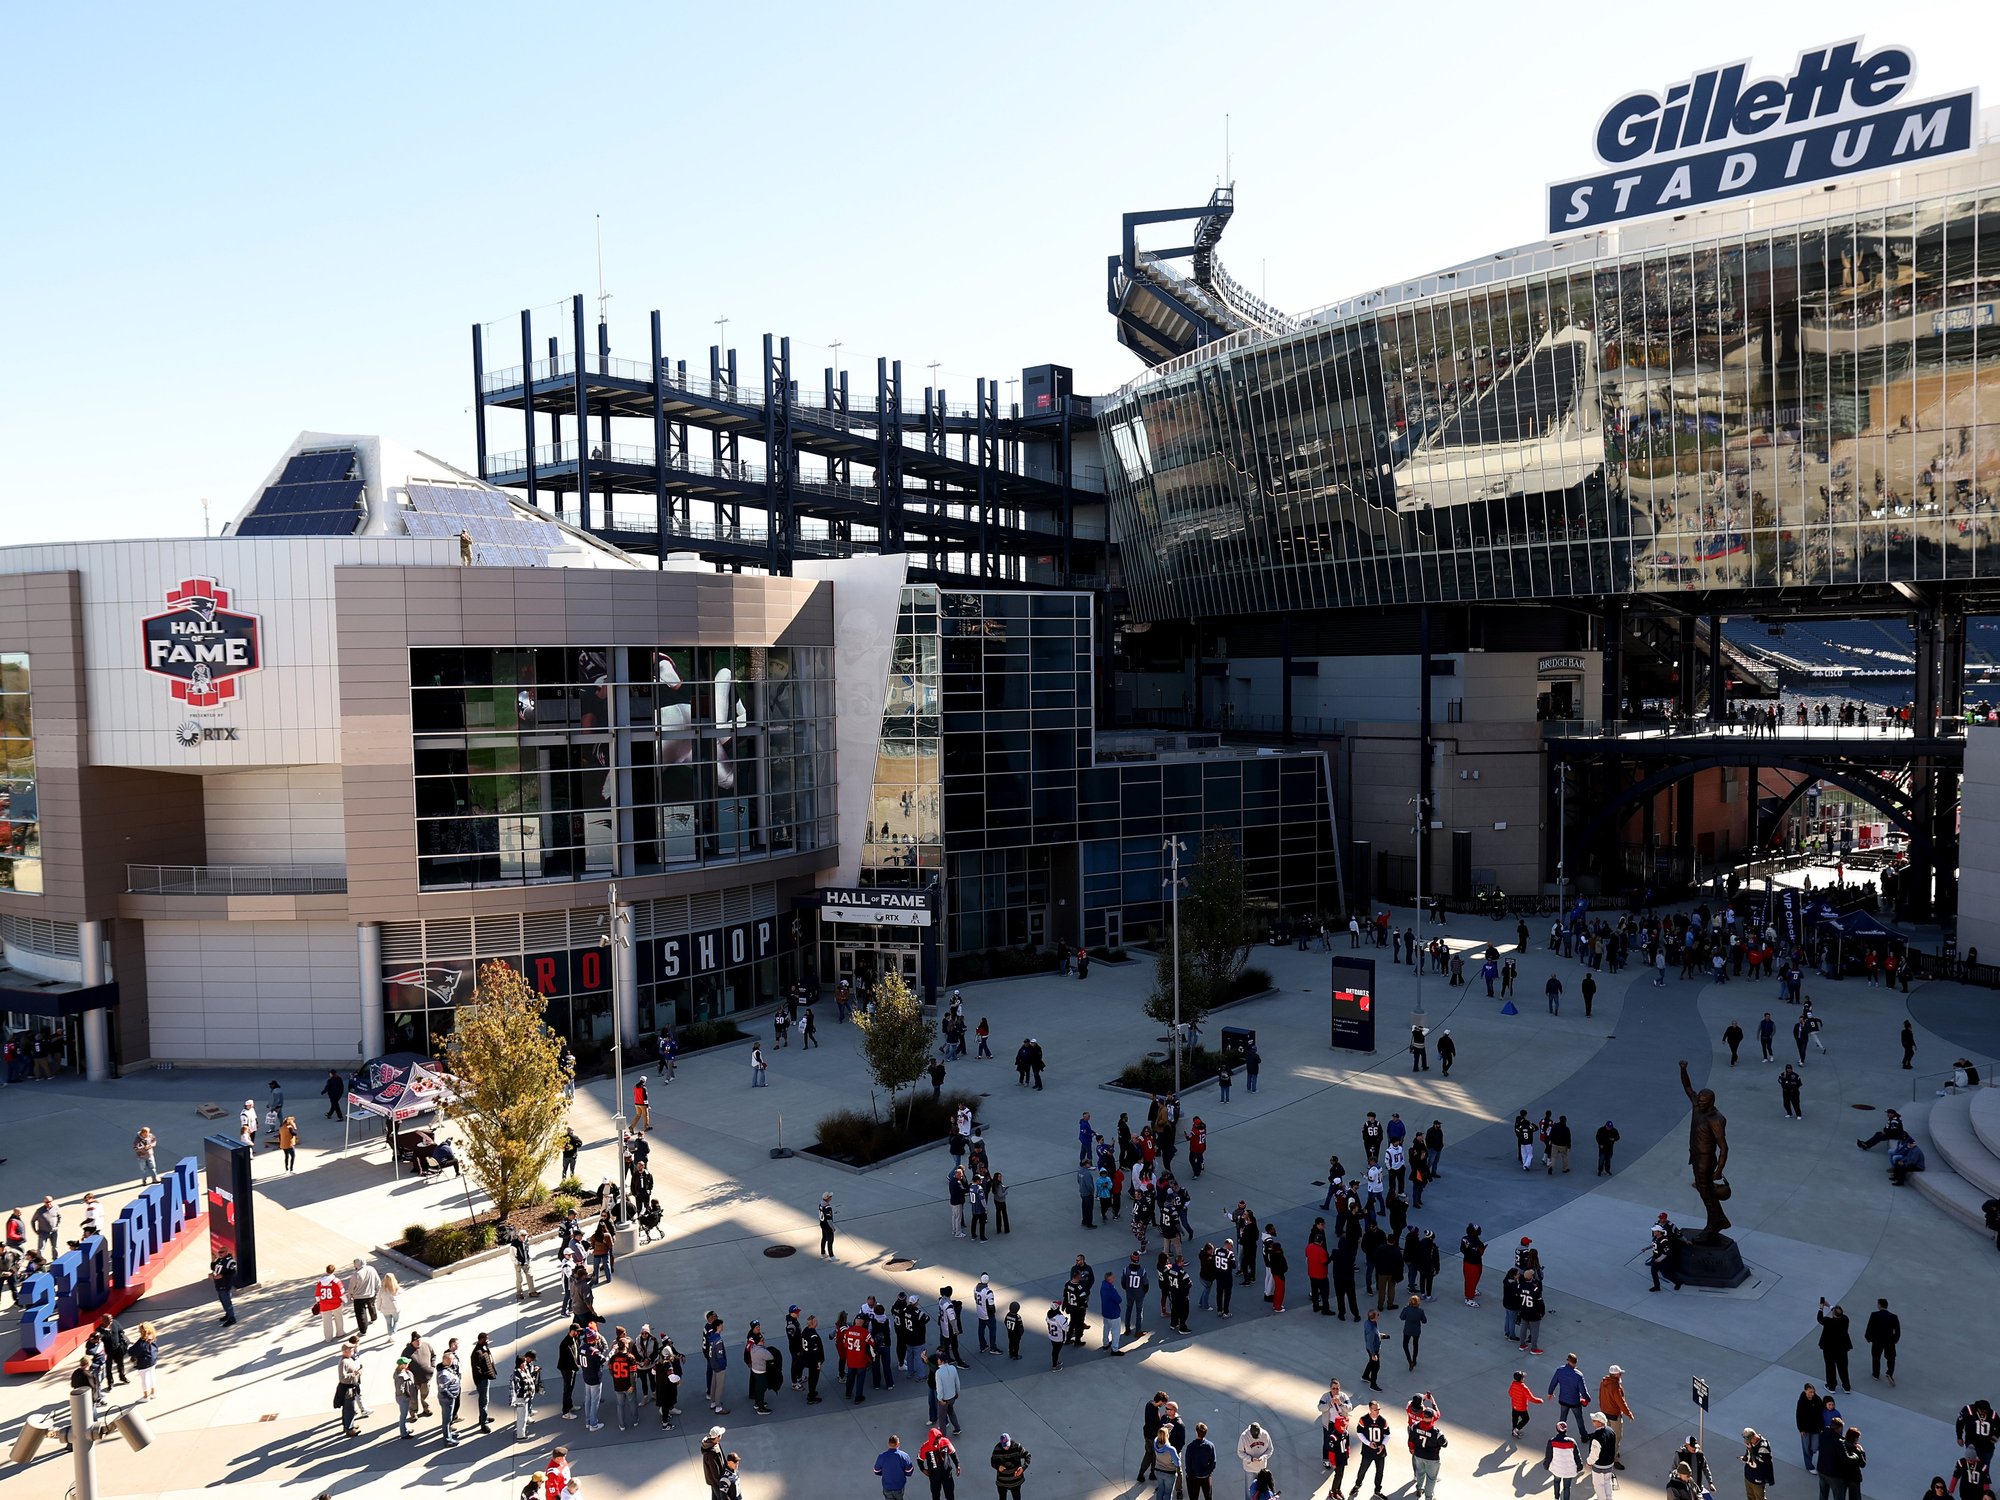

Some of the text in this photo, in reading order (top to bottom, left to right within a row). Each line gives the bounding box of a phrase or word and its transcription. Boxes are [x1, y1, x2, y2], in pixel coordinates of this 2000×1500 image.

[1597, 41, 1911, 163] Gillette
[1564, 106, 1953, 224] STADIUM
[171, 621, 225, 635] HALL
[191, 635, 204, 643] OF
[149, 638, 249, 667] FAME
[1540, 657, 1585, 670] BRIDGE BAR
[203, 728, 237, 741] RTX
[826, 891, 871, 905] HALL
[881, 894, 926, 907] FAME
[1783, 892, 1792, 909] VIP
[664, 921, 771, 977] SHOP
[1367, 1126, 1378, 1136] 66
[1215, 1255, 1229, 1271] 85
[1129, 1275, 1141, 1289] 10
[320, 1287, 334, 1300] 38
[1066, 1291, 1078, 1307] 12
[1520, 1293, 1534, 1308] 76
[904, 1318, 914, 1332] 12
[1006, 1319, 1016, 1331] 87
[847, 1337, 861, 1352] 54
[613, 1361, 630, 1379] 95
[1369, 1427, 1381, 1443] 10
[1975, 1419, 1991, 1436] 10
[1420, 1435, 1428, 1448] 7
[1966, 1469, 1981, 1485] 10
